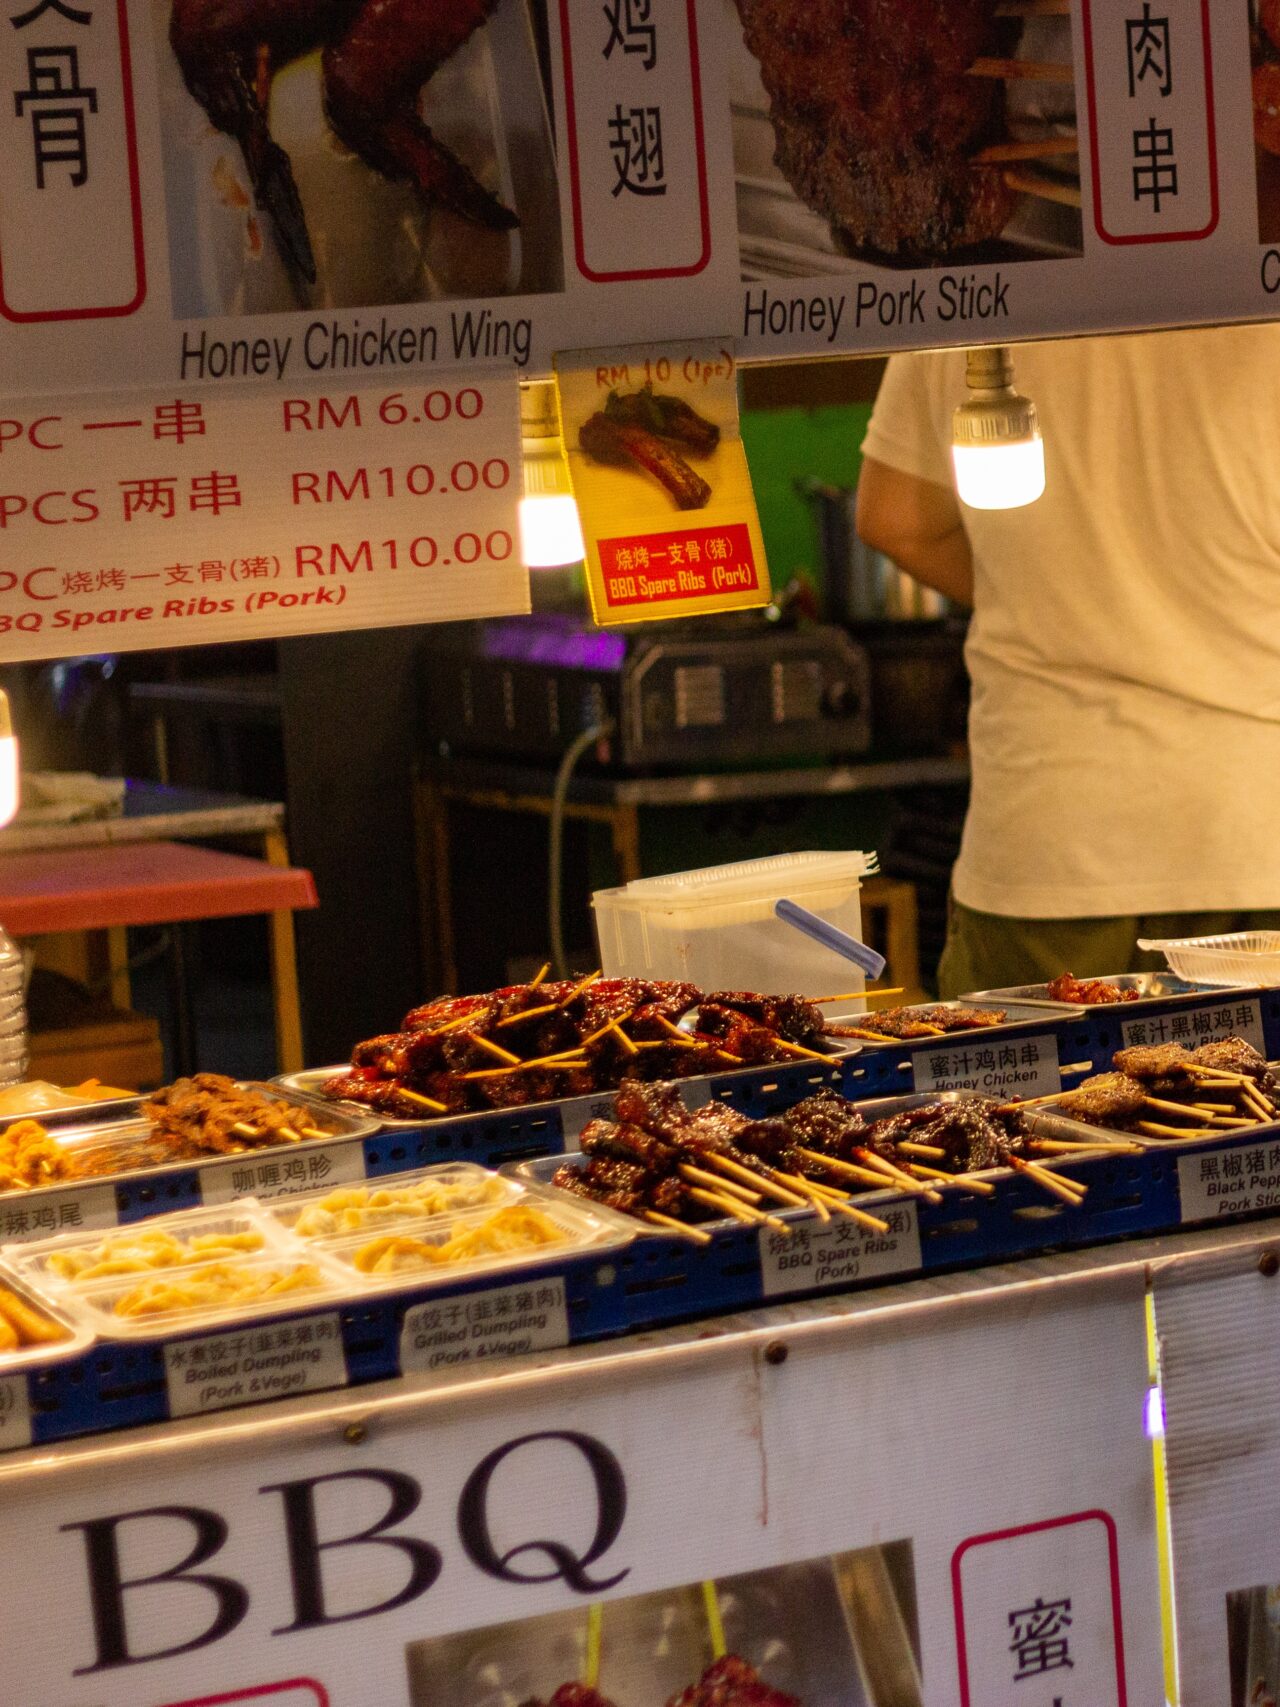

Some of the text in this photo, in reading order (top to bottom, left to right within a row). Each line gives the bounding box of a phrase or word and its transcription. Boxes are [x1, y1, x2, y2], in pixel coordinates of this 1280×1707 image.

[8, 0, 98, 189] 骨
[1125, 2, 1178, 213] 肉串
[744, 272, 1010, 342] Honey Pork Stick
[180, 310, 532, 381] Honey Chicken Wing
[83, 399, 206, 444] 一串
[283, 395, 362, 432] RM
[379, 388, 484, 425] 6.00
[0, 458, 510, 528] PCS 两串 RM10.00
[295, 530, 513, 578] RM10.00
[609, 562, 751, 599] BBQ Spare Ribs (Pork)
[51, 606, 154, 632] Spare
[162, 596, 235, 618] Ribs
[245, 584, 347, 614] (Pork)
[1127, 1005, 1254, 1047] 蜜汁黑椒鸡串
[930, 1043, 1040, 1079] 蜜汁鸡肉串
[983, 1070, 1038, 1086] Chicken
[1207, 1179, 1246, 1196] Black
[1218, 1197, 1251, 1213] Pork
[0, 1202, 84, 1236] 辣鸡尾
[778, 1239, 897, 1270] BBQ Spare Ribs
[815, 1261, 860, 1283] (Pork)
[415, 1313, 547, 1349] Grilled Dumpling
[185, 1348, 321, 1384] Boiled Dumpling
[59, 1430, 632, 1678] BBQ
